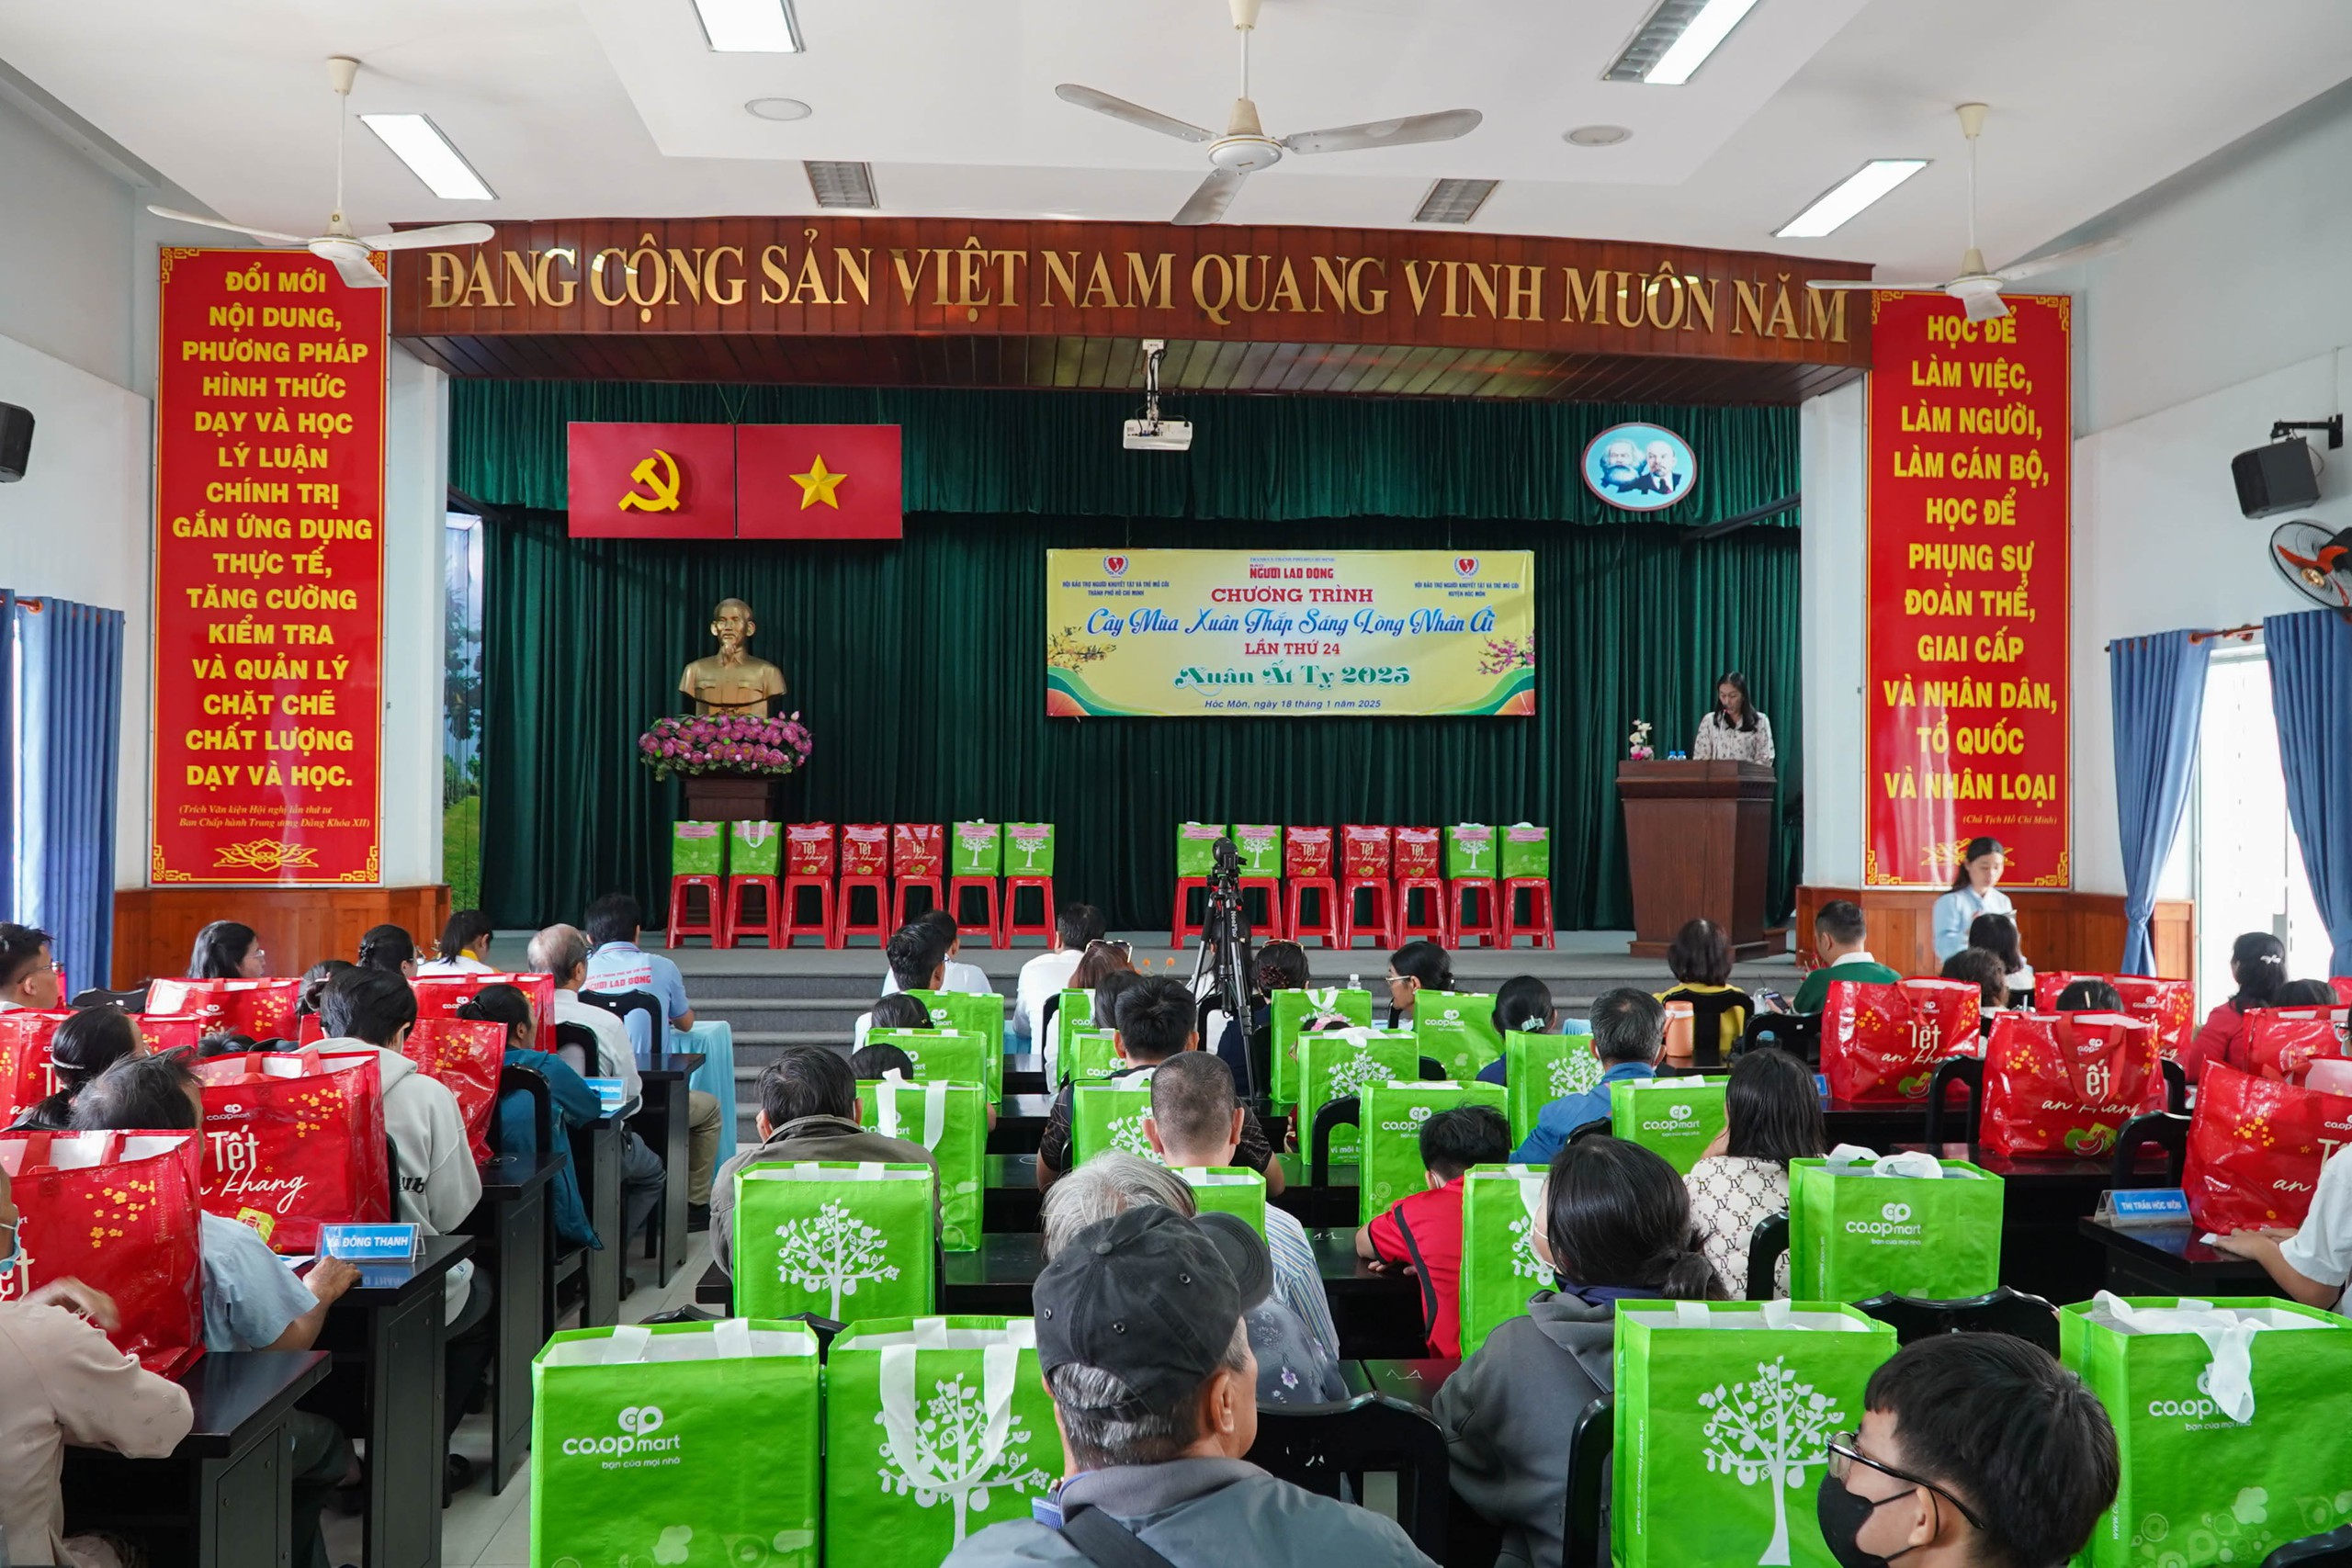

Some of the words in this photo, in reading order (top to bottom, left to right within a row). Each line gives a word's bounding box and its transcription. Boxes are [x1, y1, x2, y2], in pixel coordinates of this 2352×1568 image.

[226, 262, 269, 292] ĐỔI
[278, 269, 325, 292] MỚI
[590, 232, 747, 322] CỘNG
[761, 229, 869, 305] SẢN
[889, 236, 1026, 323] VIỆT
[1040, 249, 1175, 310] NAM
[1192, 253, 1388, 326] QUANG
[1404, 259, 1544, 321] VINH
[1562, 260, 1720, 332] MUÔN
[1731, 272, 1849, 344] NĂM
[209, 302, 254, 333] NỘI
[264, 308, 342, 331] DUNG,
[1928, 315, 1977, 349] HỌC
[1984, 305, 2016, 344] ĐỂ
[183, 338, 289, 362] PHƯƠNG
[299, 338, 368, 363] PHÁP
[203, 371, 266, 397] HÌNH
[276, 373, 345, 398] THỨC
[1912, 355, 1961, 387] LÀM
[1970, 357, 2031, 396] VIỆC,
[195, 412, 247, 437] DẠY
[255, 407, 289, 432] VÀ
[299, 413, 353, 439] HỌC
[1902, 400, 1951, 433] LÀM
[1960, 402, 2041, 440] NGƯỜI,
[219, 442, 250, 468] LÝ
[259, 445, 328, 474] LUẬN
[1894, 445, 1944, 478] LÀM
[1951, 446, 2001, 479] CÁN
[2010, 449, 2048, 488] BỘ,
[207, 478, 288, 502] CHÍNH
[298, 483, 339, 510] TRỊ
[1927, 498, 1977, 532] HỌC
[1984, 487, 2016, 525] ĐỂ
[173, 509, 228, 538] GẮN
[237, 513, 290, 538] ỨNG
[300, 519, 372, 545] DỤNG
[213, 550, 283, 579] THỰC
[292, 547, 332, 578] TẾ,
[1284, 569, 1303, 579] LAO
[1909, 543, 1993, 576] PHỤNG
[2001, 541, 2034, 580] SỰ
[187, 584, 257, 608] TĂNG
[266, 585, 356, 610] CƯỜNG
[1211, 585, 1303, 603] CHƯƠNG
[1309, 584, 1374, 603] TRÌNH
[1905, 583, 1973, 616] ĐOÀN
[1981, 579, 2035, 623] THỂ,
[209, 615, 274, 644] KIỂM
[283, 625, 334, 645] TRA
[1087, 607, 1125, 637] Cây
[1129, 608, 1180, 633] Mùa
[1184, 607, 1238, 634] Xuân
[1245, 608, 1293, 637] Thắp
[1298, 607, 1349, 637] Sáng
[1353, 608, 1405, 637] Lòng
[1409, 608, 1464, 634] Nhân
[1245, 638, 1279, 655] LẦN
[1284, 639, 1318, 655] THỨ
[1324, 643, 1340, 655] 24
[1918, 635, 1967, 661] GIAI
[1975, 626, 2024, 662] CẤP
[192, 654, 227, 679] VÀ
[235, 652, 307, 681] QUẢN
[317, 655, 349, 680] LÝ
[1173, 665, 1254, 691] Xuân
[1262, 660, 1293, 683] Ất
[1300, 665, 1334, 690] Tỵ
[1342, 666, 1410, 684] 2025
[204, 690, 274, 720] CHẶT
[282, 690, 335, 716] CHẼ
[1205, 700, 1224, 708] Hóc
[1227, 700, 1250, 709] Môn,
[1254, 700, 1276, 709] ngày
[1295, 700, 1322, 709] tháng
[1883, 674, 1916, 707] VÀ
[1924, 676, 1992, 708] NHÂN
[2000, 677, 2057, 715] DÂN,
[186, 722, 256, 750] CHẤT
[266, 728, 353, 756] LƯỢNG
[1917, 715, 1949, 753] TỔ
[1957, 717, 2024, 755] QUỐC
[187, 766, 239, 791] DẠY
[248, 761, 282, 785] VÀ
[291, 766, 352, 792] HỌC.
[1884, 766, 1917, 799] VÀ
[1925, 768, 1993, 800] NHÂN
[2001, 774, 2056, 808] LOẠI
[179, 806, 207, 814] (Trích
[229, 806, 247, 815] kiện
[250, 806, 266, 814] Hội
[268, 806, 287, 816] nghị
[289, 805, 303, 814] lần
[306, 806, 321, 814] thứ
[179, 818, 196, 827] Ban
[199, 817, 222, 828] Chấp
[225, 818, 246, 827] hành
[250, 818, 275, 828] Trung
[301, 818, 324, 828] Đảng
[327, 818, 350, 827] Khóa
[353, 818, 369, 827] XII)
[1963, 815, 1982, 824] (Chủ
[1985, 815, 2002, 825] Tịch
[2004, 815, 2015, 824] Hồ
[2018, 816, 2031, 824] Chí
[2034, 815, 2057, 825] Minh)
[1882, 1053, 1907, 1062] an
[1643, 1121, 1700, 1131] co.opmart
[207, 1124, 260, 1172] Tết
[220, 1170, 308, 1213] khang
[2273, 1179, 2312, 1191] an
[343, 1235, 371, 1247] ĐÔNG
[374, 1236, 408, 1248] THẠNH
[1846, 1222, 1921, 1236] co.opmart
[2185, 1423, 2202, 1431] bạn
[562, 1435, 680, 1457] co.opmart
[644, 1459, 660, 1467] mọi
